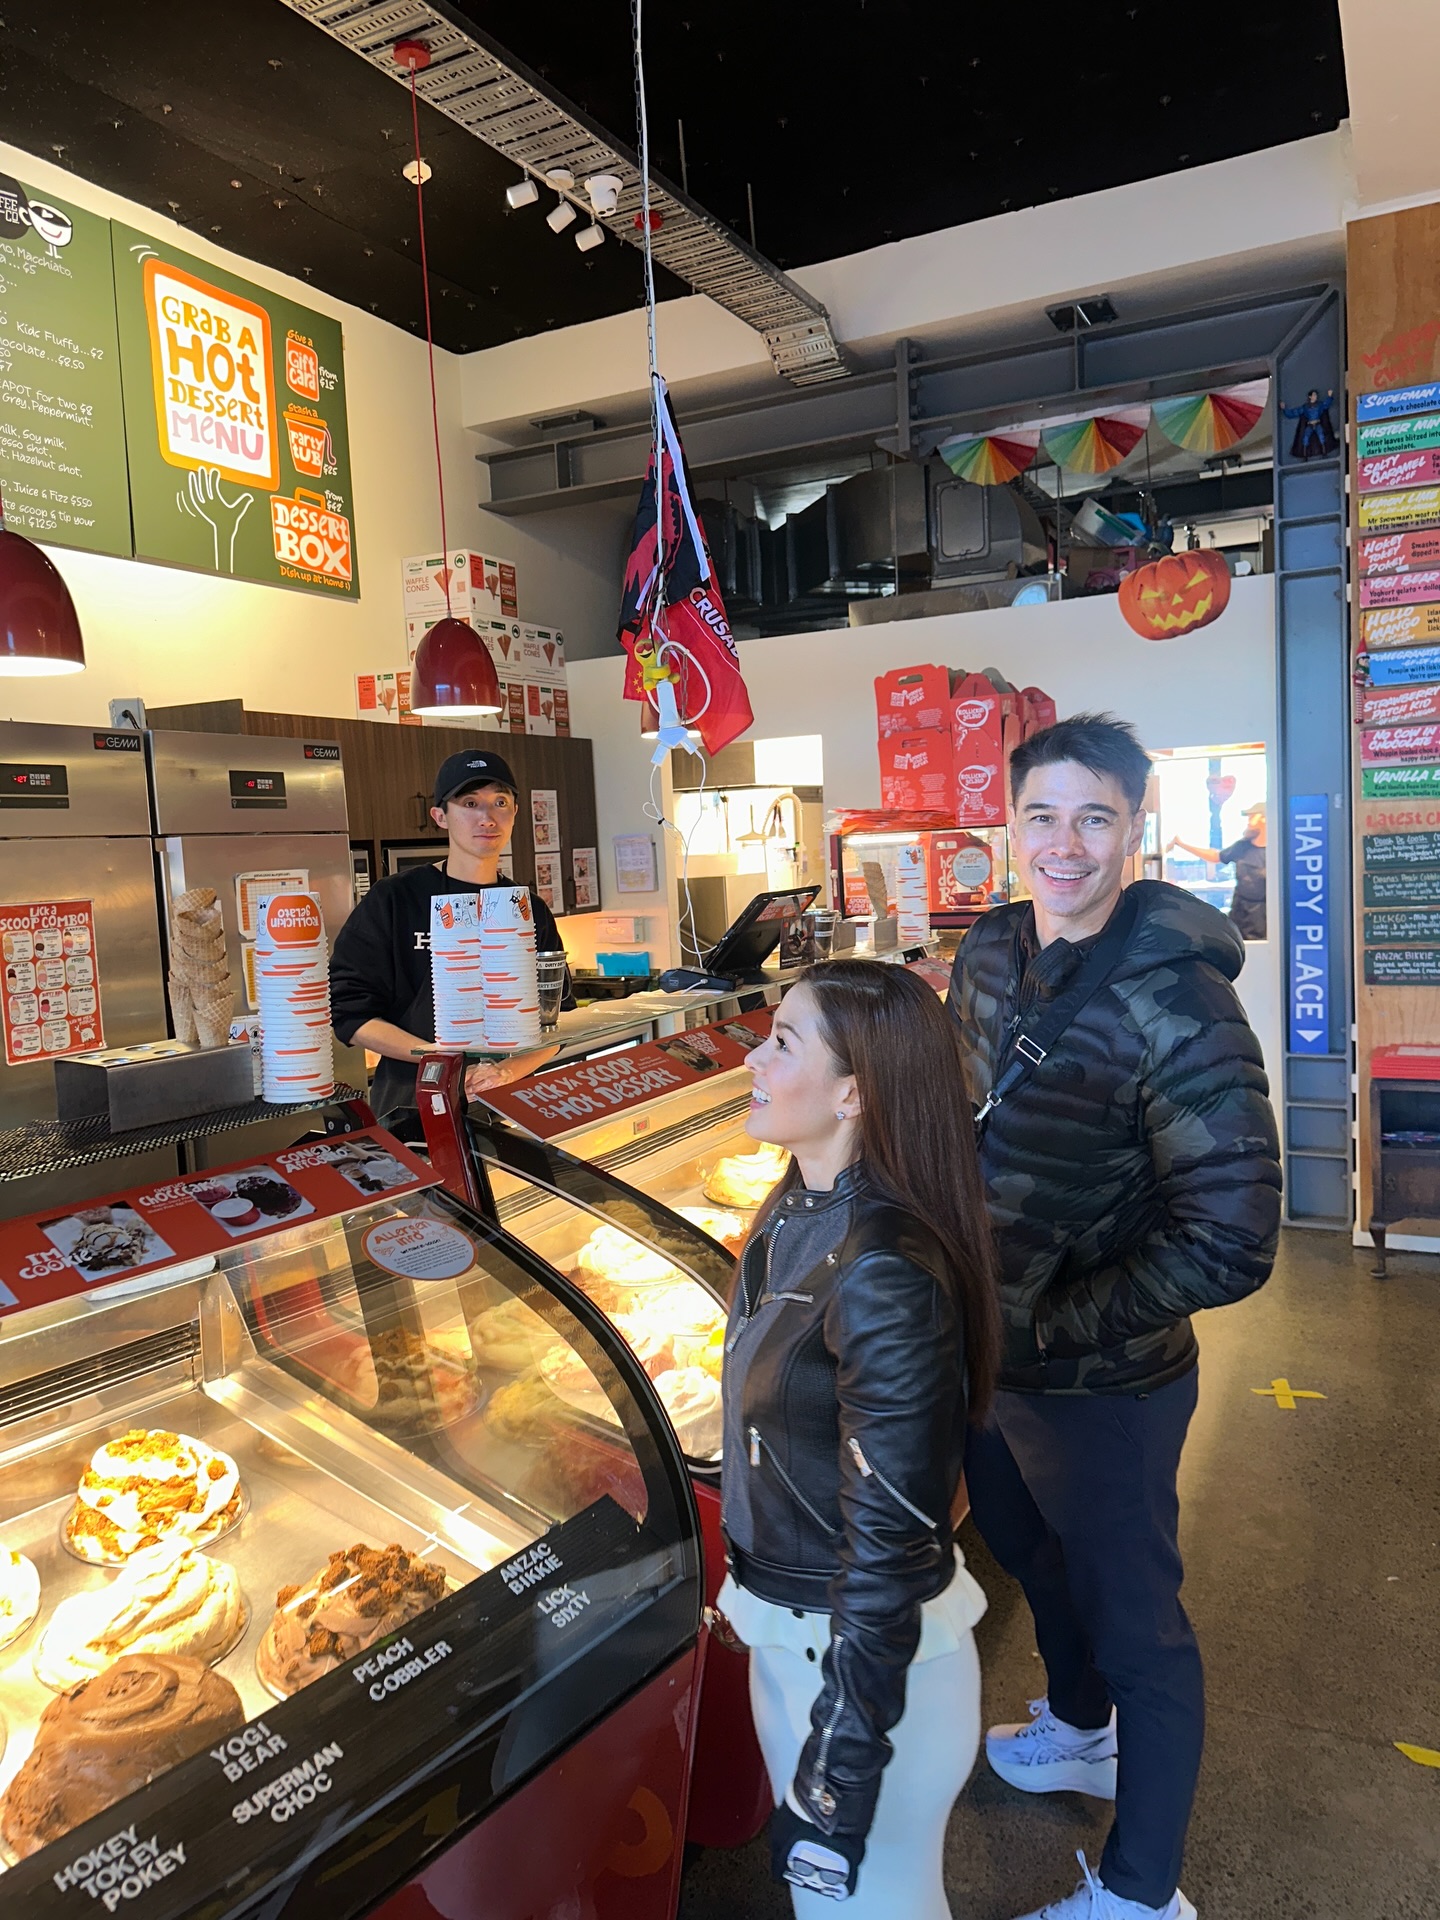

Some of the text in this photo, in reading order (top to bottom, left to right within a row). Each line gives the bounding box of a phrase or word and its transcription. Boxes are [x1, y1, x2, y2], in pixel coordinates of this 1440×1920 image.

[17, 246, 73, 278] Macchiato,
[16, 321, 41, 338] Kids
[287, 329, 313, 347] Give a
[237, 327, 259, 355] A
[288, 350, 316, 375] Gift
[319, 366, 339, 382] from
[320, 376, 335, 391] $15
[36, 390, 93, 416] for two $8
[1364, 387, 1437, 409] SUPERMAN
[1406, 399, 1437, 410] chocolate
[32, 400, 94, 429] Peppermint,
[23, 430, 67, 451] Soy milk,
[1360, 423, 1411, 440] MISTER
[1366, 432, 1428, 448] Mint leaves blitzed
[1367, 447, 1382, 455] dark
[12, 450, 56, 470] Hazelnut
[58, 463, 83, 478] shot,
[323, 463, 338, 476] $25
[1362, 454, 1400, 477] SALTY
[1370, 456, 1426, 485] CARAMEL
[12, 480, 39, 497] Juice
[49, 489, 69, 504] Fizz
[325, 489, 344, 504] from
[1363, 494, 1406, 510] LEMON
[1408, 490, 1439, 503] LIME
[19, 504, 48, 518] scoop
[58, 510, 71, 523] tip
[74, 516, 95, 527] your
[327, 501, 342, 512] $42
[1367, 518, 1377, 526] Mr
[275, 526, 351, 577] BOX
[1411, 550, 1432, 558] dipped
[280, 565, 301, 579] Dish
[302, 571, 312, 582] up
[313, 573, 322, 583] at
[324, 575, 344, 589] home
[405, 576, 429, 586] WAFFLE
[1370, 572, 1440, 589] YOGI BEAR
[406, 584, 430, 593] CONES
[1369, 585, 1417, 598] Yoghurt gelato
[1366, 606, 1414, 631] HELLO
[1369, 616, 1420, 641] MANGO
[523, 642, 540, 650] WAFFLE
[524, 649, 540, 658] CONES
[1363, 685, 1440, 713] STRAWBERRY
[1371, 704, 1408, 721] PATCH
[1409, 698, 1432, 712] KID
[1422, 726, 1438, 737] IN
[106, 737, 138, 749] GEMM
[313, 748, 338, 758] GEMM
[1368, 736, 1433, 751] CHOCOLATE
[1373, 769, 1429, 784] VANILLA
[0, 912, 89, 931] SCOOP COMBO!
[1295, 813, 1324, 1019] HAPPY PLACE
[1375, 951, 1434, 961] ANZAC BIKKIE
[579, 1057, 640, 1087] SCOOP
[538, 1107, 557, 1119] &
[25, 1247, 63, 1266] I'M
[500, 1542, 552, 1584] ANZAC
[508, 1554, 564, 1596] BIKKIE
[537, 1583, 577, 1615] LICK
[551, 1591, 591, 1629] SIXTY
[352, 1637, 414, 1684] PEACH
[369, 1640, 453, 1702] COBBLER
[210, 1721, 271, 1765] YOGI
[222, 1734, 288, 1783] BEAR
[232, 1741, 344, 1825] SUPERMAN
[270, 1773, 333, 1823] CHOC
[53, 1823, 139, 1893] HOKEY
[80, 1835, 161, 1899] TOKEY
[101, 1841, 188, 1913] POKEY
